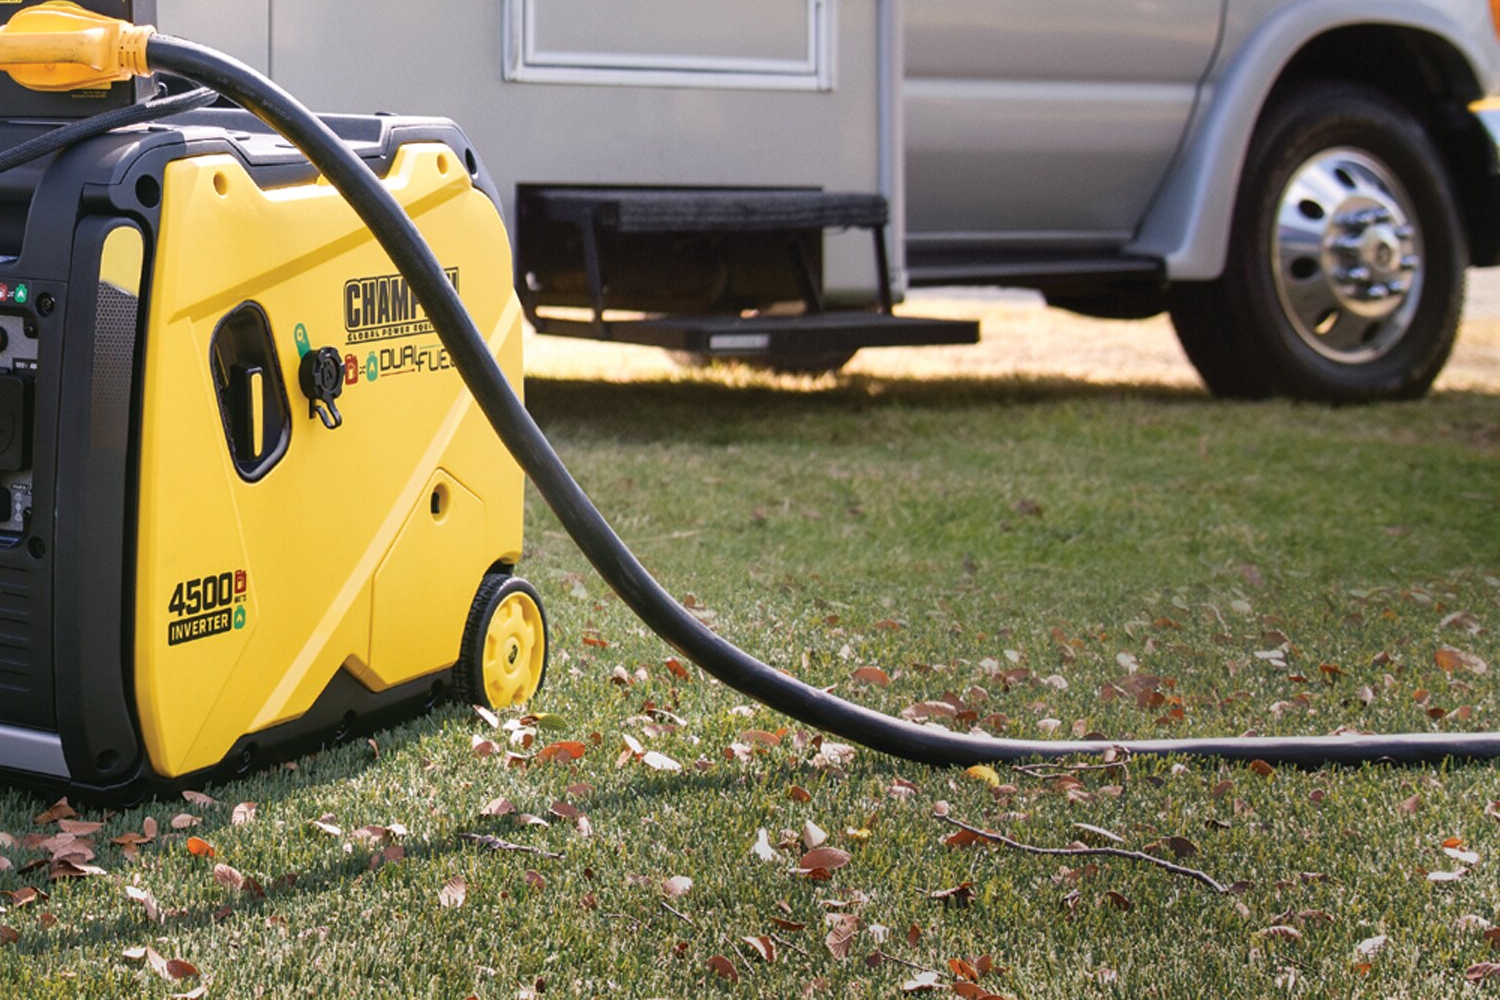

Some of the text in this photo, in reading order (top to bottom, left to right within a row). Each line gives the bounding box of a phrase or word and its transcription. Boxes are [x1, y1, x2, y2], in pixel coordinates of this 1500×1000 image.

[347, 330, 380, 342] GLOBAL
[382, 325, 410, 337] POWER
[380, 345, 456, 373] DUAL FUE
[168, 572, 233, 617] 4500
[171, 613, 229, 641] INVERTER
